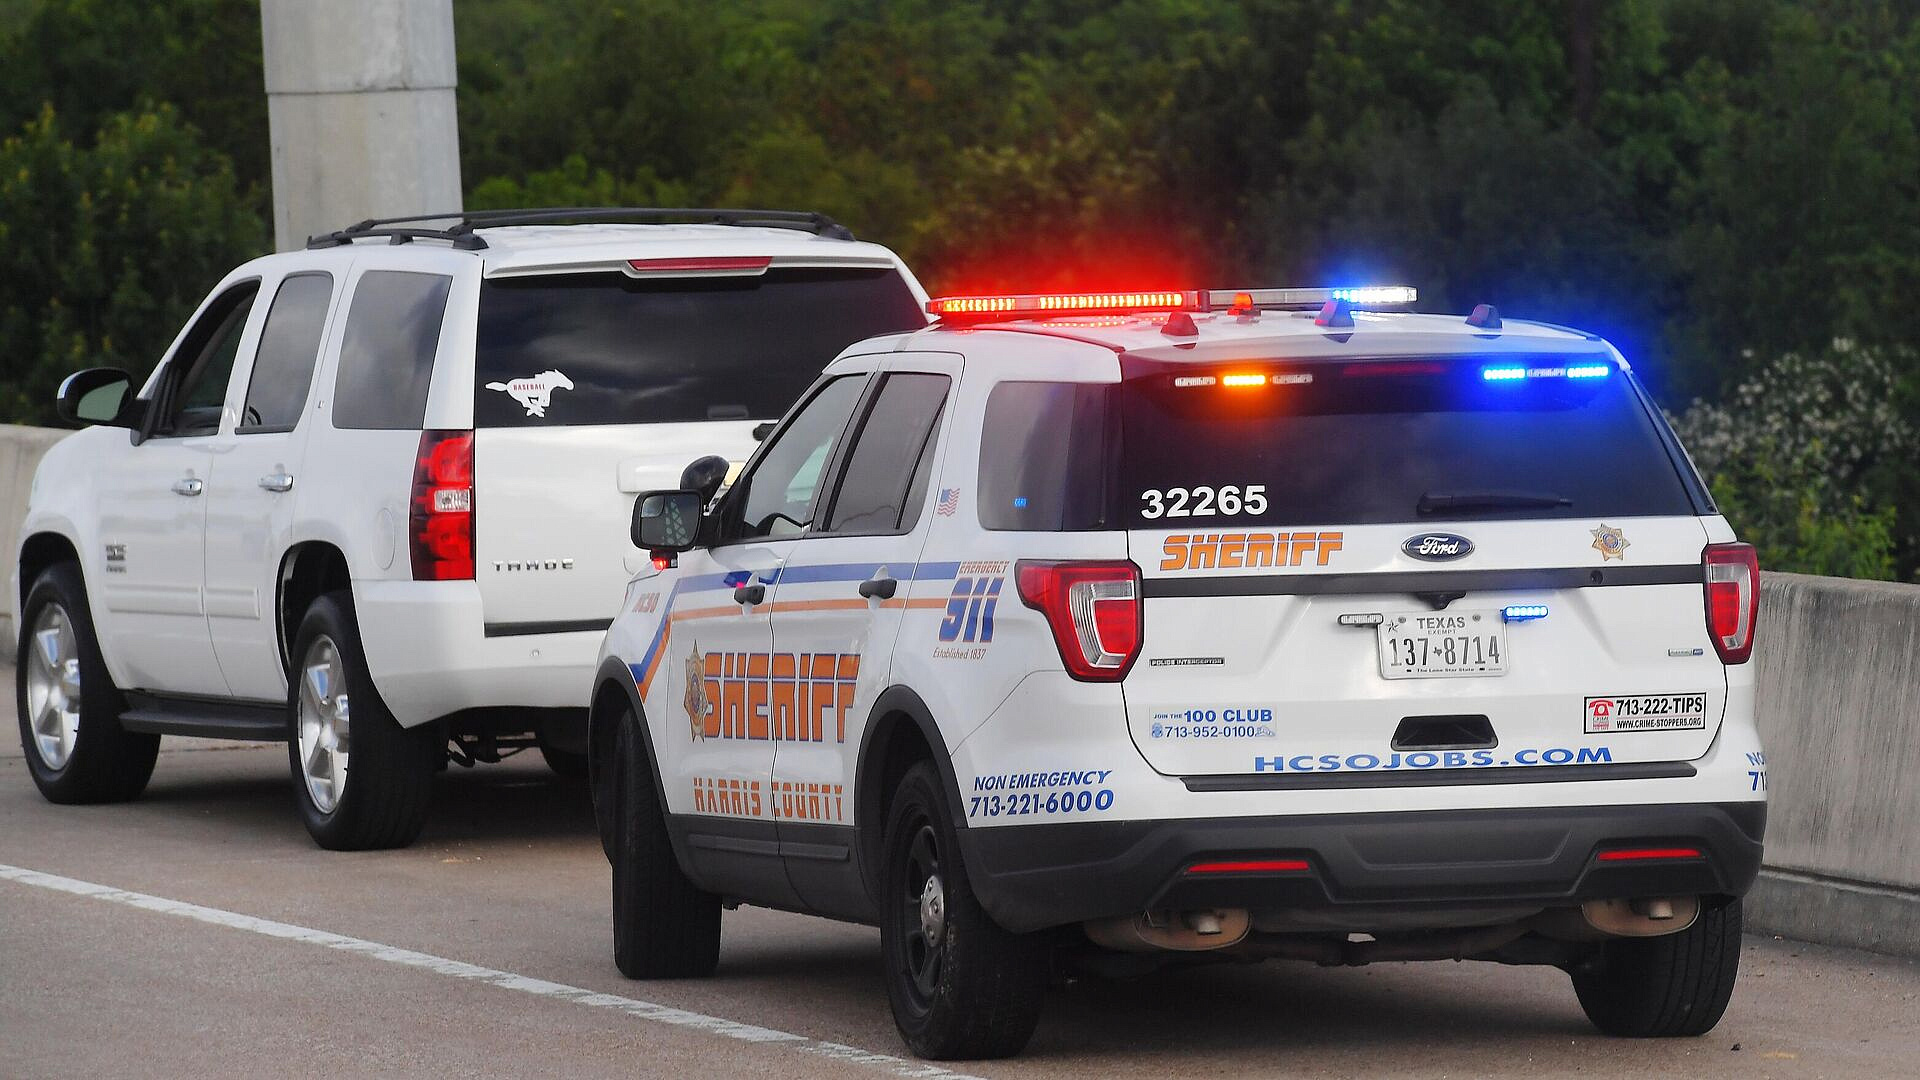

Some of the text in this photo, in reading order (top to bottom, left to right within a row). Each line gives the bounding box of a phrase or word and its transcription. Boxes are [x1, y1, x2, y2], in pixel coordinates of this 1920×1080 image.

[512, 383, 545, 391] BASEBALL
[1141, 485, 1268, 519] 32265
[1160, 532, 1343, 571] SHERIFF
[1415, 537, 1460, 555] Ford
[493, 559, 574, 572] TAHOE
[939, 577, 1005, 643] 911
[1416, 617, 1466, 629] TEXAS
[932, 646, 987, 660] Established 1837
[703, 652, 861, 743] SHERIFF
[1616, 697, 1703, 716] 713-222-TIPS
[1184, 710, 1216, 722] 100
[1223, 709, 1272, 722] CLUB
[1616, 718, 1702, 729] WWW.CRIME-STOPPERS.ORG
[1165, 726, 1254, 738] 713-952-0100
[1255, 747, 1612, 772] HCSOJOBS.COM
[974, 770, 1113, 791] NON EMERGENCY
[693, 777, 843, 821] HARRIS COUNTY
[970, 789, 1114, 817] 713-221-6000
